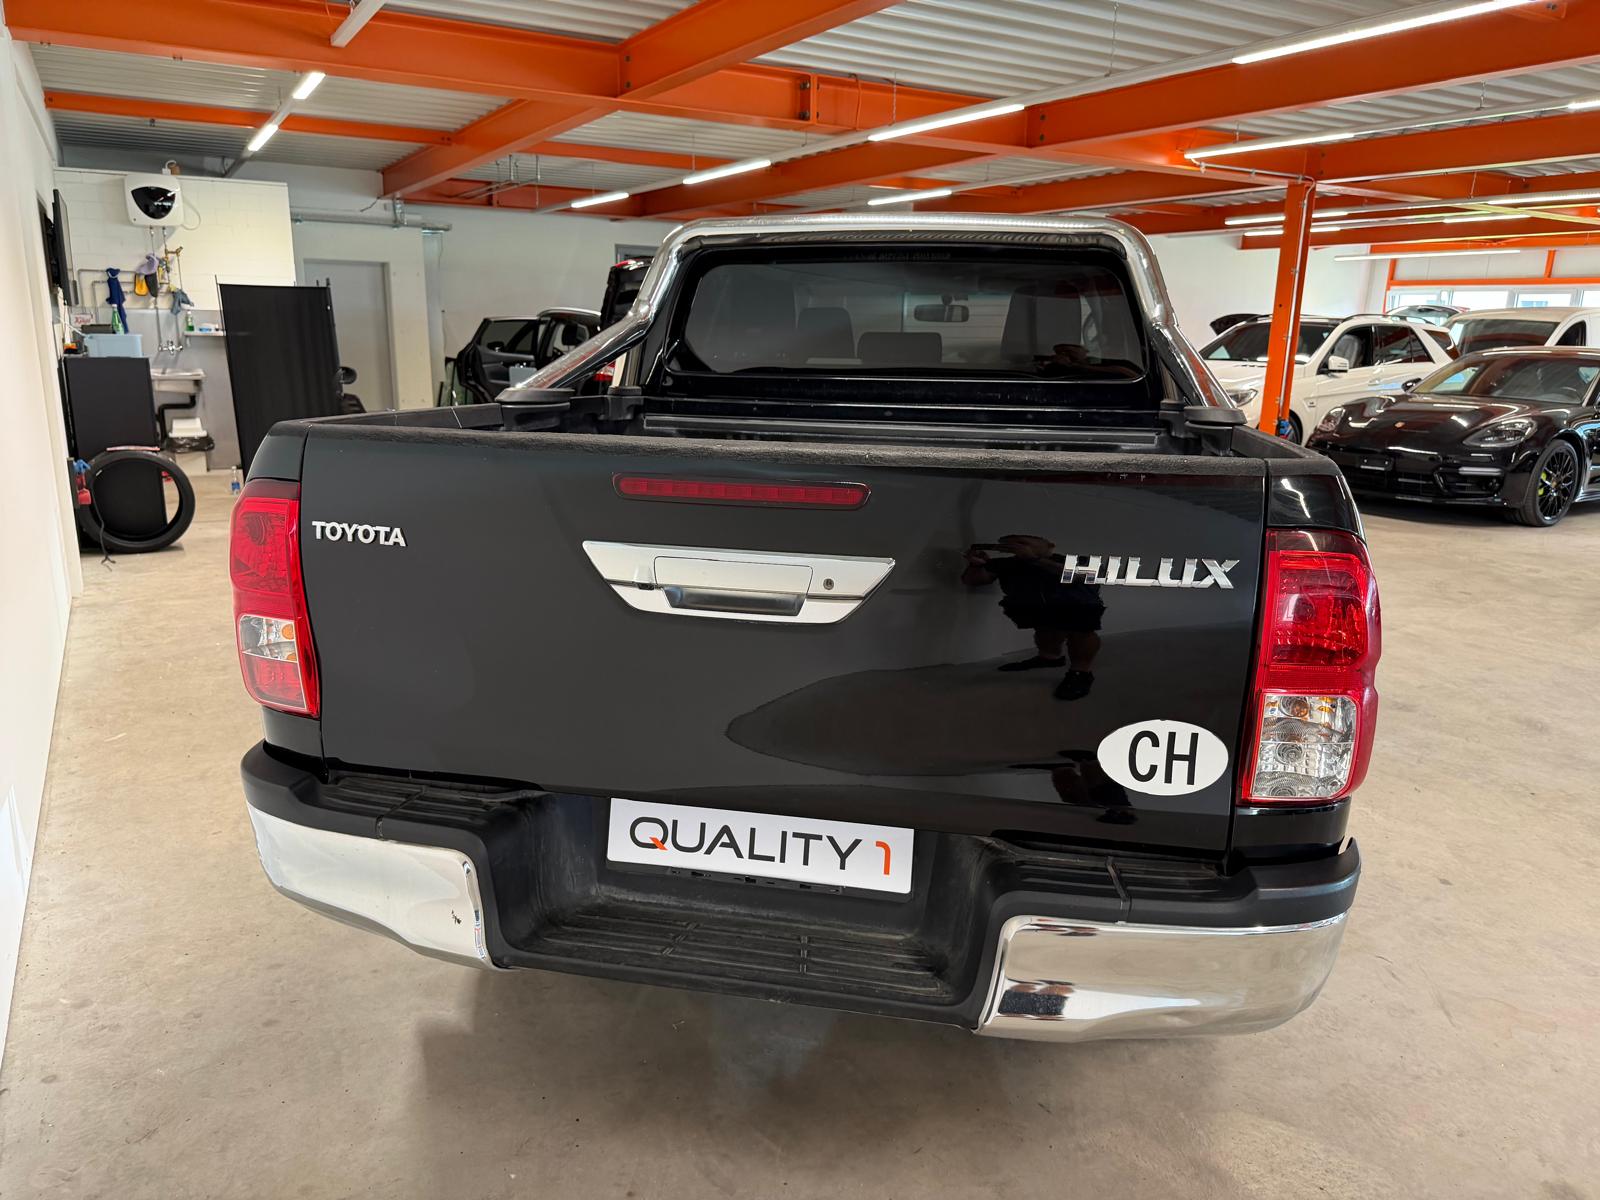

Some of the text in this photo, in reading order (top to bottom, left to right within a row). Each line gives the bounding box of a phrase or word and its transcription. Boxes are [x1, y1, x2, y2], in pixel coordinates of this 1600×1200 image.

[312, 520, 407, 547] TOYOTA
[1061, 554, 1240, 589] HILUX
[1128, 730, 1199, 785] CH
[629, 816, 863, 870] QUALITY
